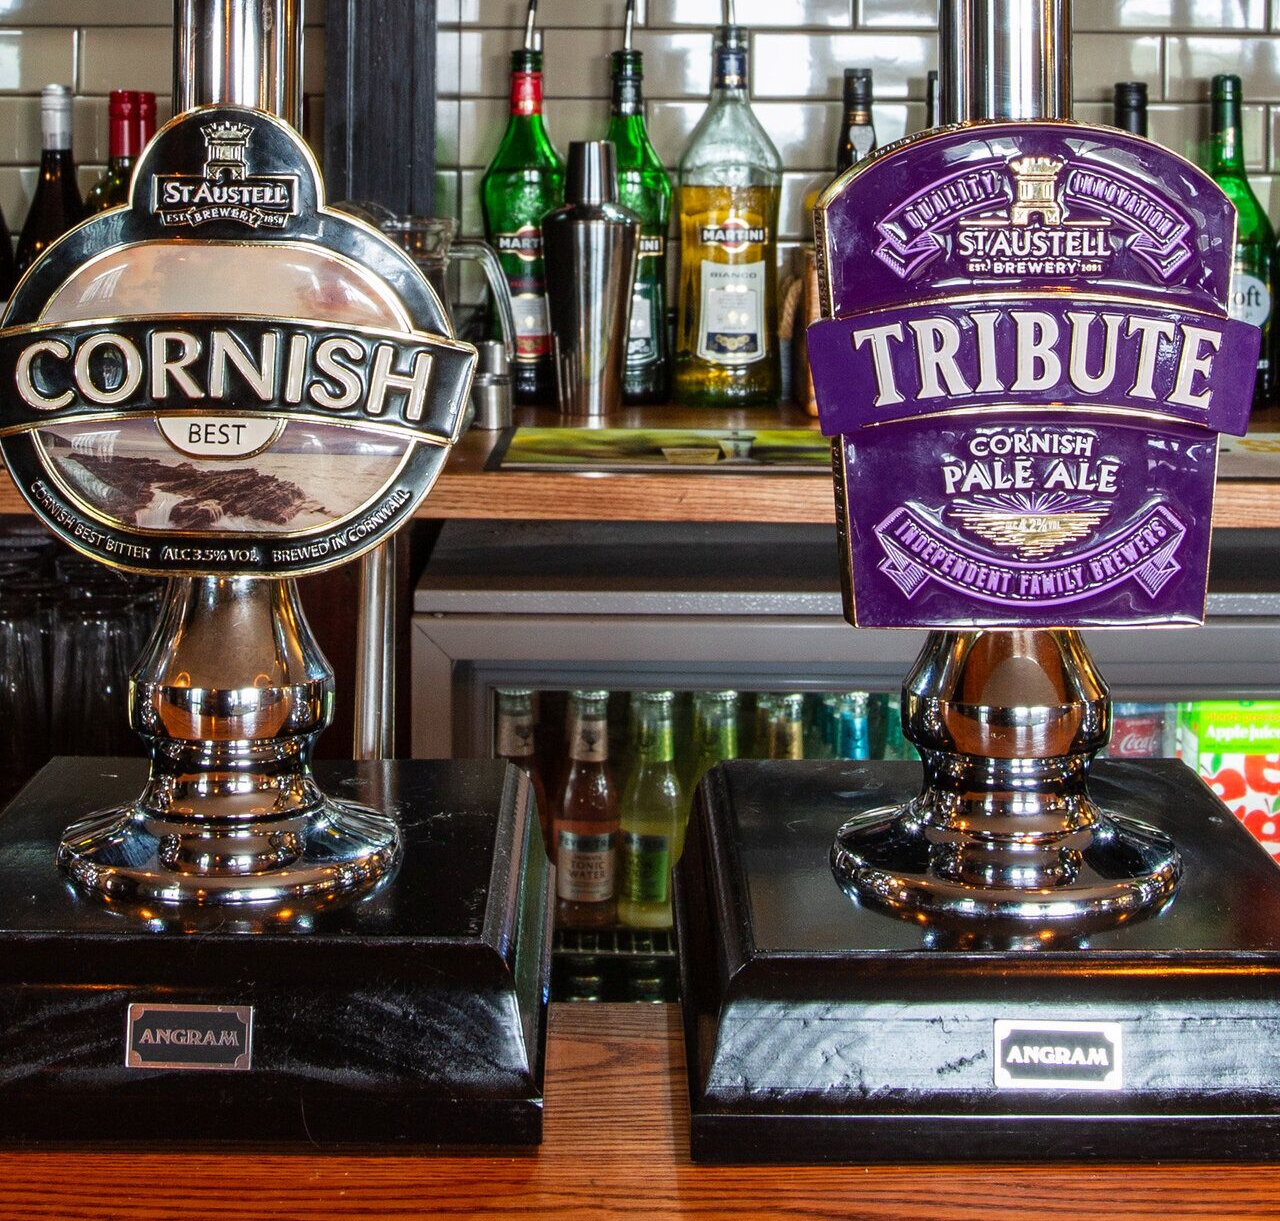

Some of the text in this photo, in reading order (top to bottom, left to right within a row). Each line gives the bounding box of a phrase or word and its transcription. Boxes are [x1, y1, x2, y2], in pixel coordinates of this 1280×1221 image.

[906, 171, 996, 229] QUALITY
[1073, 171, 1174, 237] INNOVATION
[195, 207, 257, 224] BREWERY
[701, 229, 765, 243] MARTINI
[986, 229, 1112, 257] AUSTELL
[709, 271, 758, 279] BIANCO
[993, 262, 1077, 275] BREWERY
[852, 310, 1223, 410] TRIBUTE
[15, 330, 434, 420] CORNISH
[188, 423, 248, 446] BEST
[969, 430, 1094, 458] CORNISH
[942, 458, 1121, 494] PALE ALE
[30, 482, 151, 560] CORNISH BEST BITTER
[272, 488, 412, 563] BREWED IN CORNWALL
[163, 548, 191, 562] ALC
[192, 548, 228, 562] 3.5%
[892, 516, 1168, 596] INDEPENDENT FAMILY BREWERS
[138, 1028, 241, 1047] ANGRAM
[1005, 1045, 1110, 1067] ANGRAM
